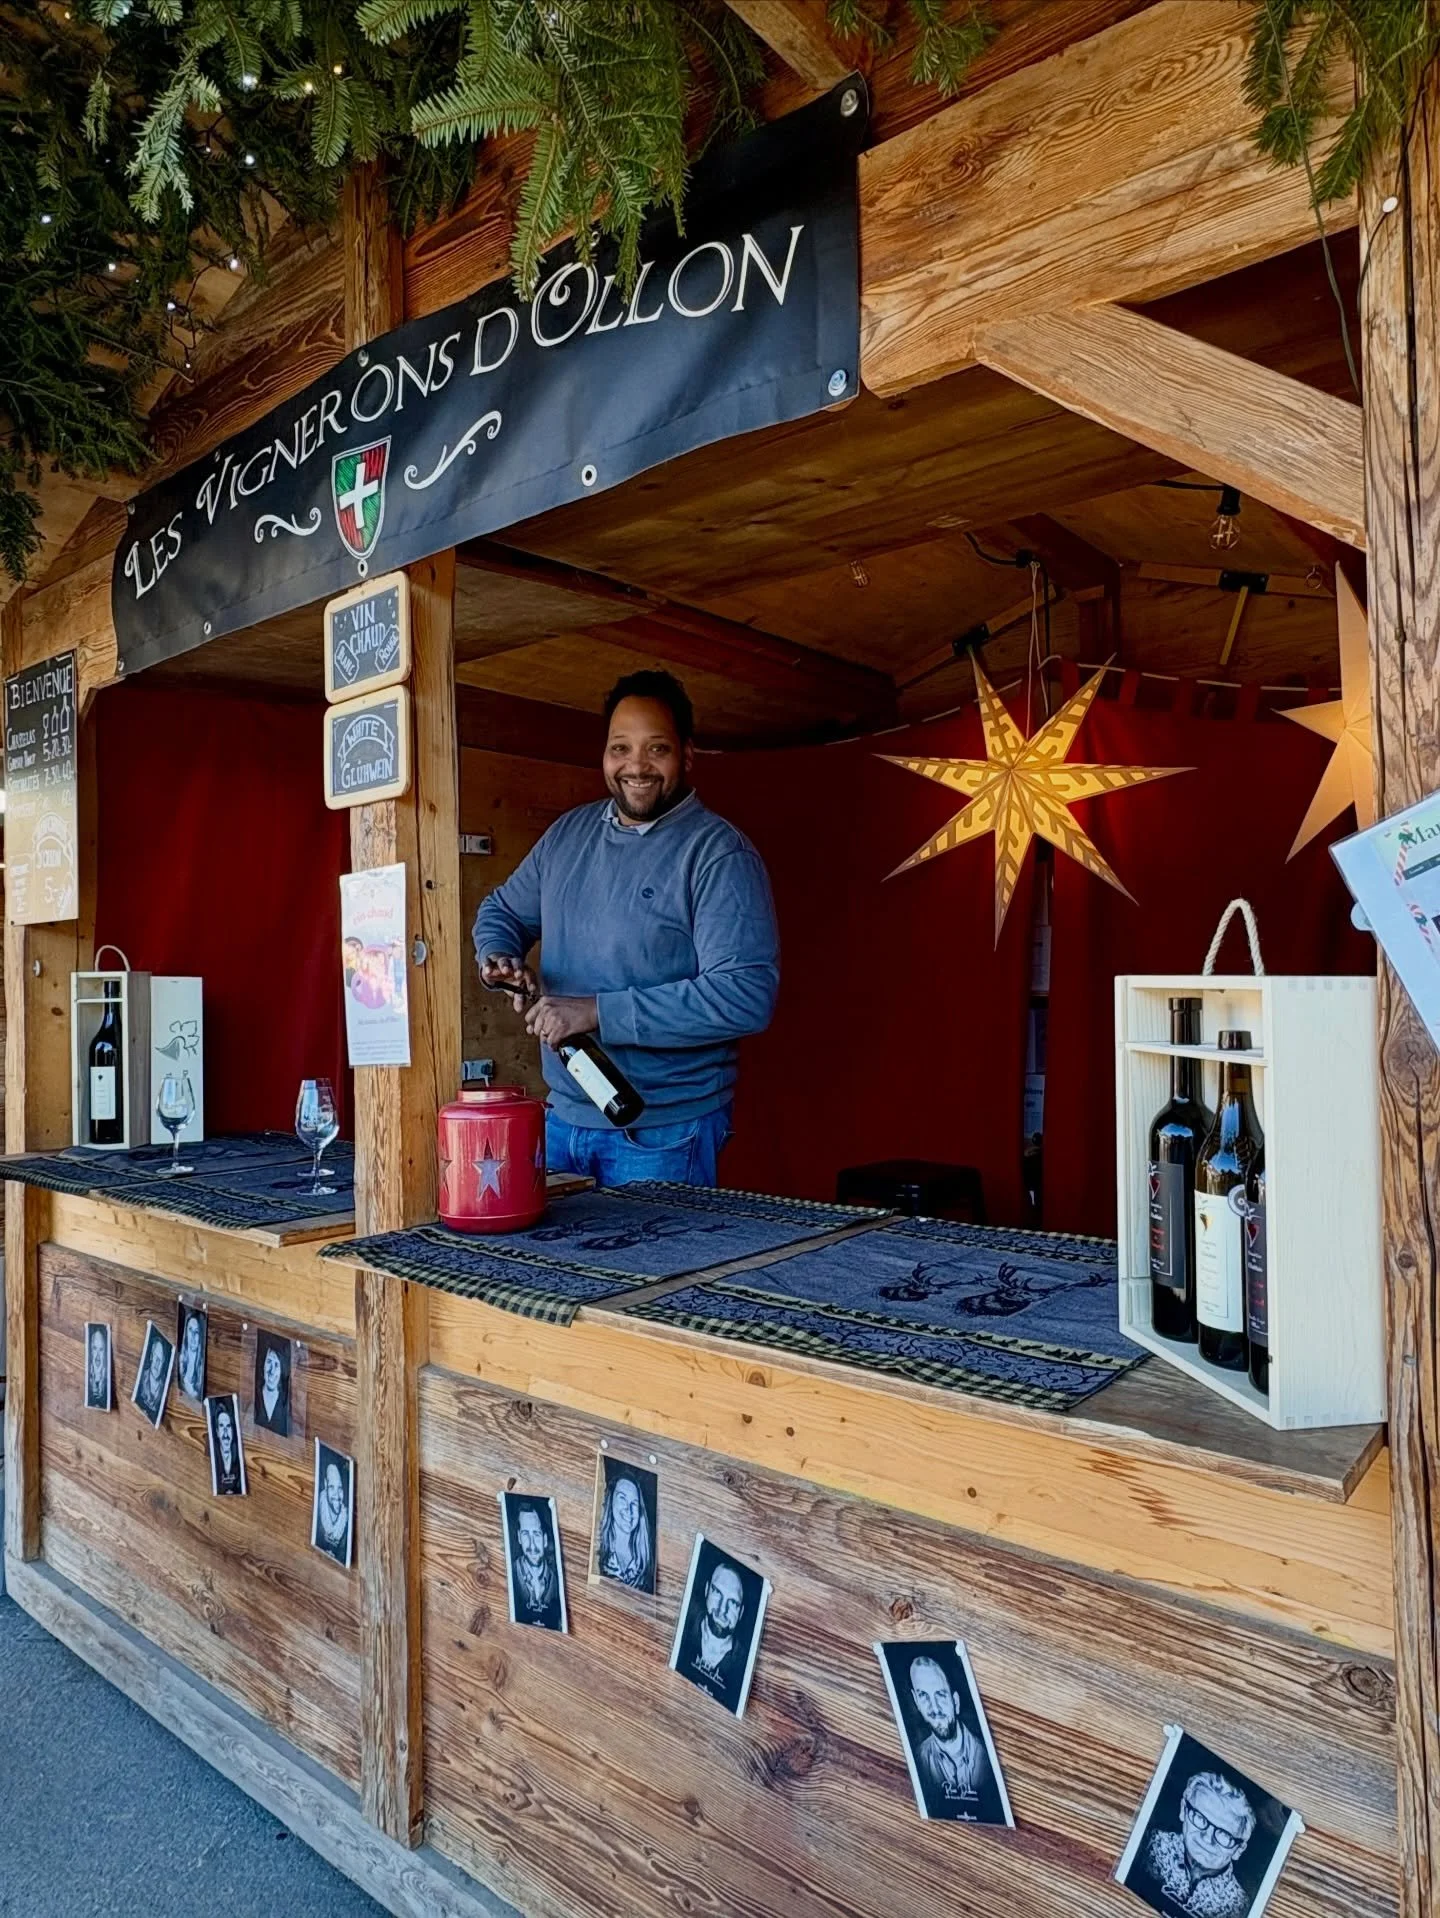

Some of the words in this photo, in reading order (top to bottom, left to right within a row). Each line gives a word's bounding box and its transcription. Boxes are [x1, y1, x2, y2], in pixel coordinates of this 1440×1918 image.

[124, 512, 182, 599] LES
[196, 332, 461, 525] VIGNERONS
[351, 601, 375, 630] VIN
[350, 622, 385, 654] CHAUD
[10, 664, 72, 709] BIENVENUE
[346, 720, 380, 746] WHITE
[342, 758, 392, 788] GLÜHWEIN
